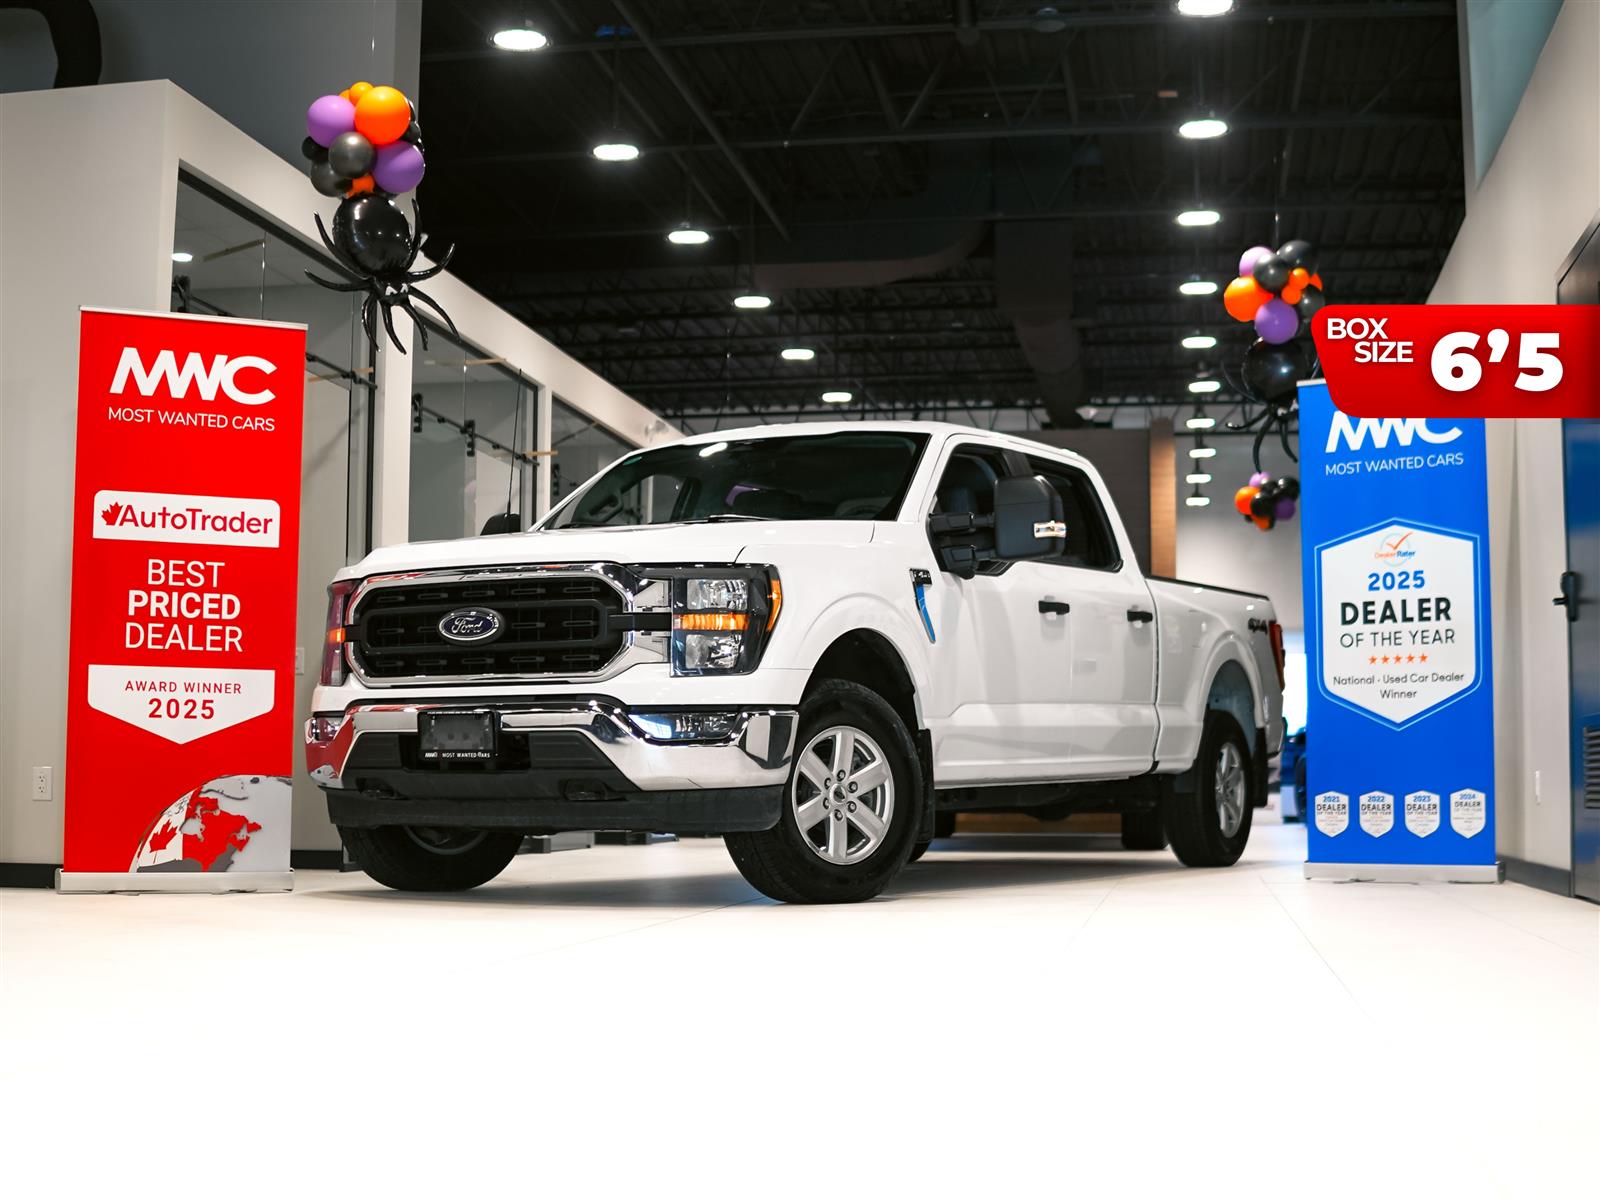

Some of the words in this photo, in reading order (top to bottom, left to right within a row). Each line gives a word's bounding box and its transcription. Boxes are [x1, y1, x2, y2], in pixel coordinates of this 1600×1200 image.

[109, 346, 278, 405] MWC
[108, 406, 155, 423] MOST
[157, 410, 228, 428] WANTED
[232, 416, 275, 431] CARS
[1325, 410, 1464, 453] MWC
[1325, 461, 1361, 476] MOST
[1364, 455, 1425, 472] WANTED
[1426, 452, 1464, 467] CARS
[119, 504, 273, 534] AutoTrader
[147, 559, 226, 587] BEST
[1367, 570, 1426, 592] 2025
[127, 589, 241, 620] PRICED
[1340, 597, 1452, 626] DEALER
[125, 622, 243, 652] DEALER
[451, 616, 484, 634] Ford
[1339, 632, 1365, 648] OF
[1370, 630, 1403, 647] THE
[1408, 628, 1456, 645] YEAR
[125, 680, 178, 693] AWARD
[183, 682, 242, 695] WINNER
[1333, 674, 1375, 686] National
[1382, 673, 1408, 684] Used
[1410, 673, 1429, 683] Car
[1431, 672, 1465, 682] Dealer
[1379, 689, 1418, 699] Winner
[148, 698, 215, 719] 2025
